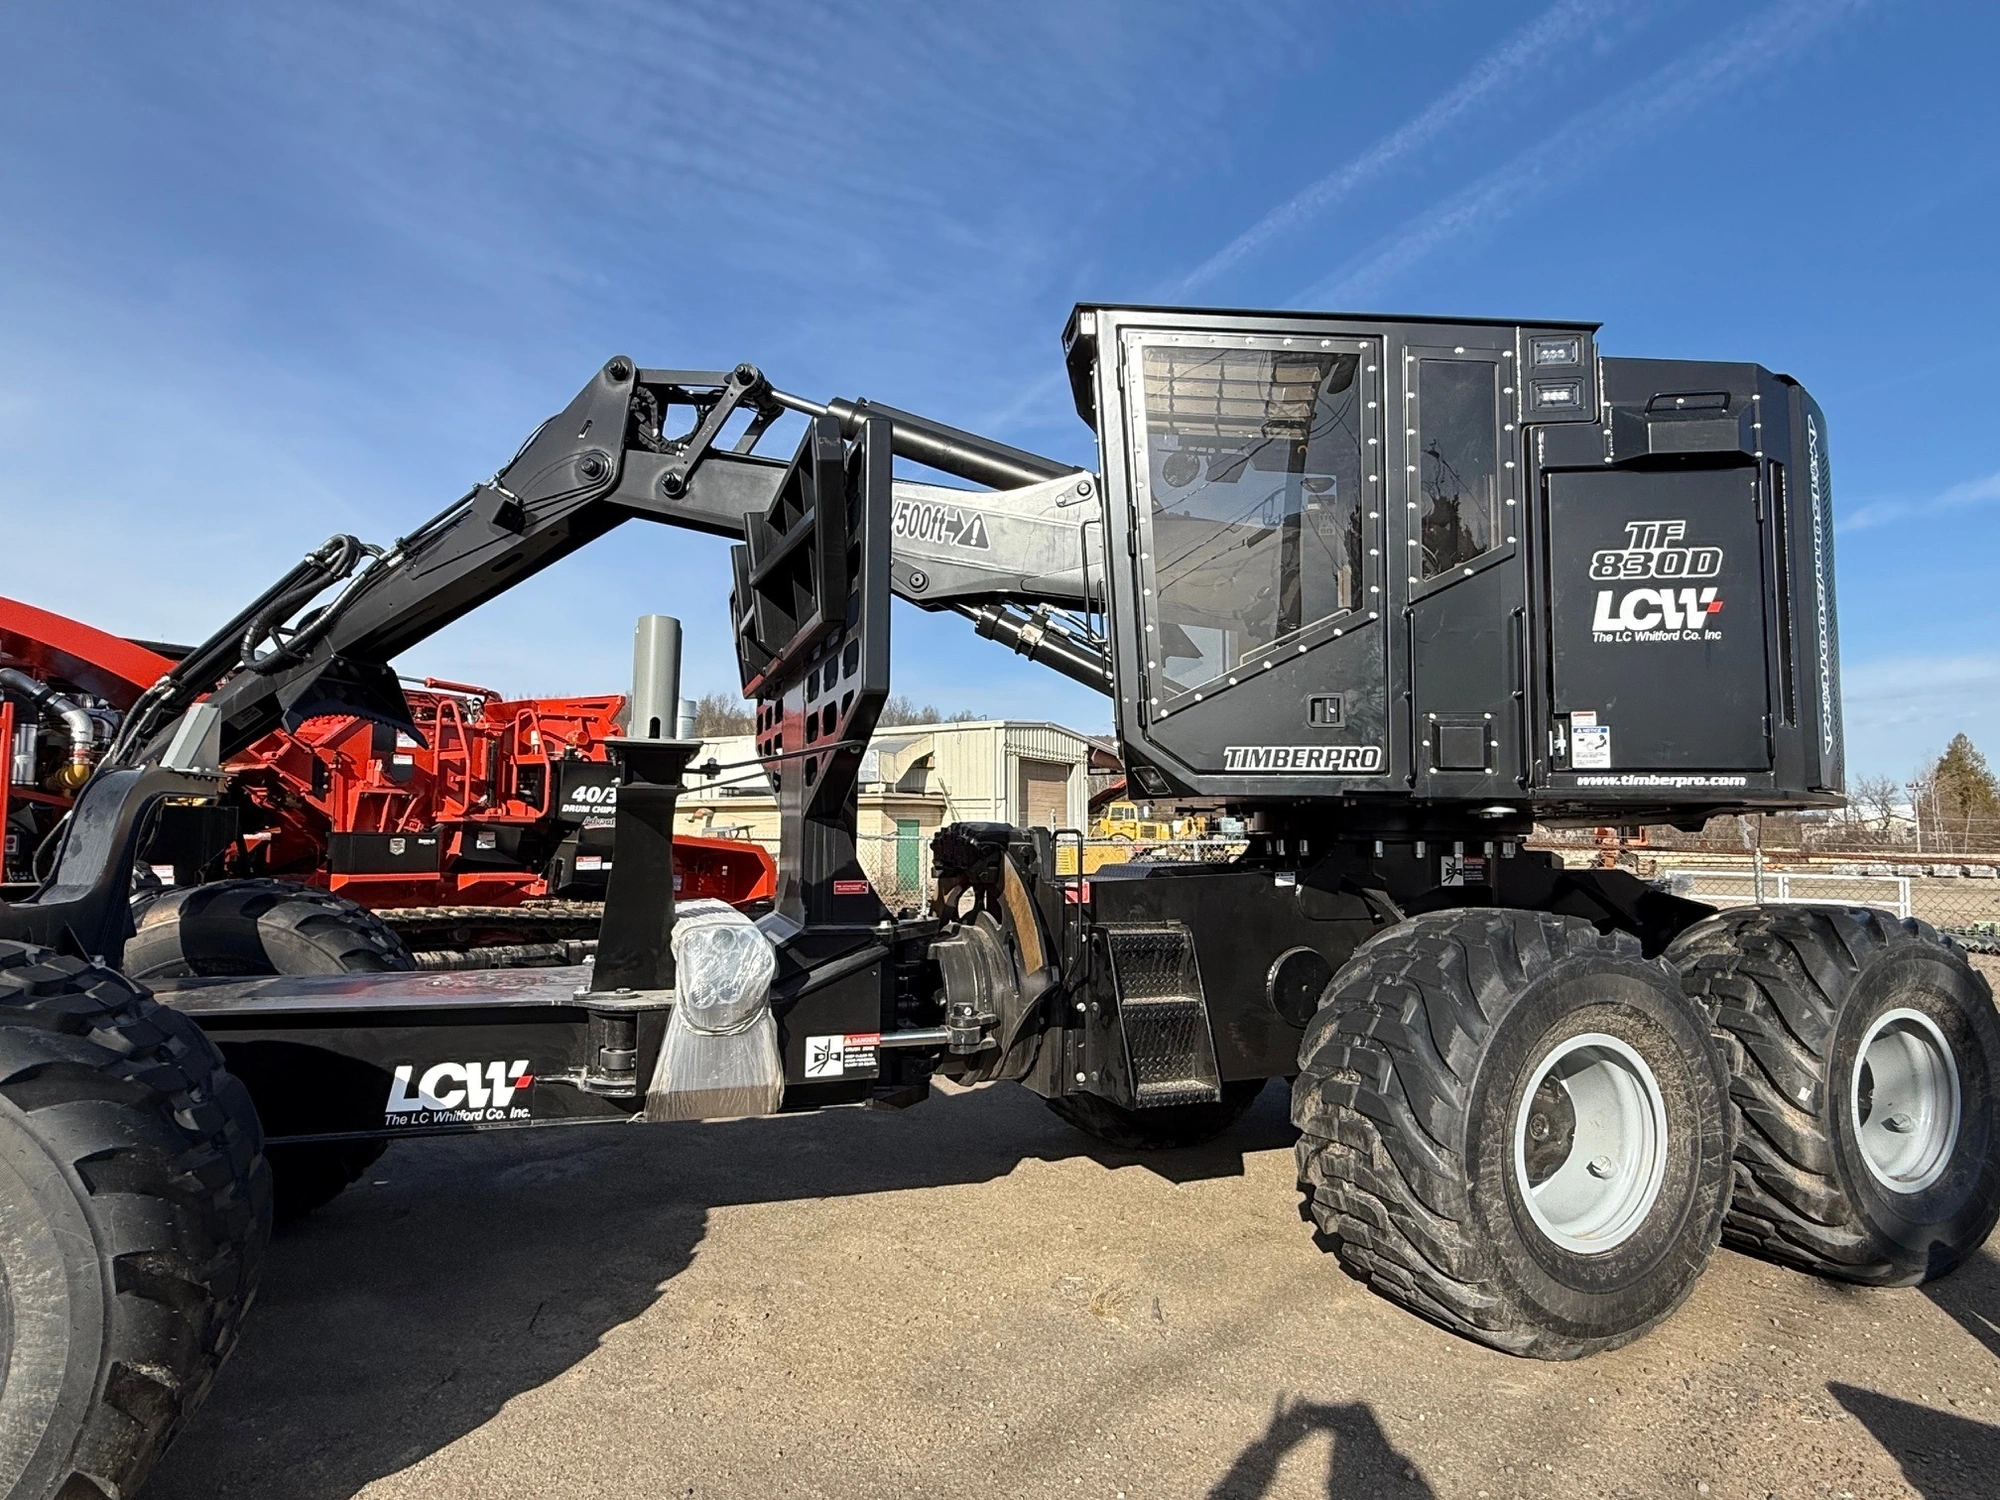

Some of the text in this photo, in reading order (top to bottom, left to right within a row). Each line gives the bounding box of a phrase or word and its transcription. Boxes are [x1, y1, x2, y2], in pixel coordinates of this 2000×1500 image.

[1625, 520, 1686, 550] TF
[1589, 547, 1723, 580] 830D
[1592, 587, 1718, 631] LCW
[1592, 629, 1722, 642] The LC Whitford Co. Inc
[1224, 746, 1382, 771] TIMBERPRO
[1576, 775, 1747, 788] www.timberpro.com
[562, 804, 591, 813] DRUM
[385, 1060, 530, 1112] LCW
[385, 1107, 531, 1126] The LC Whitford Co. Inc.
